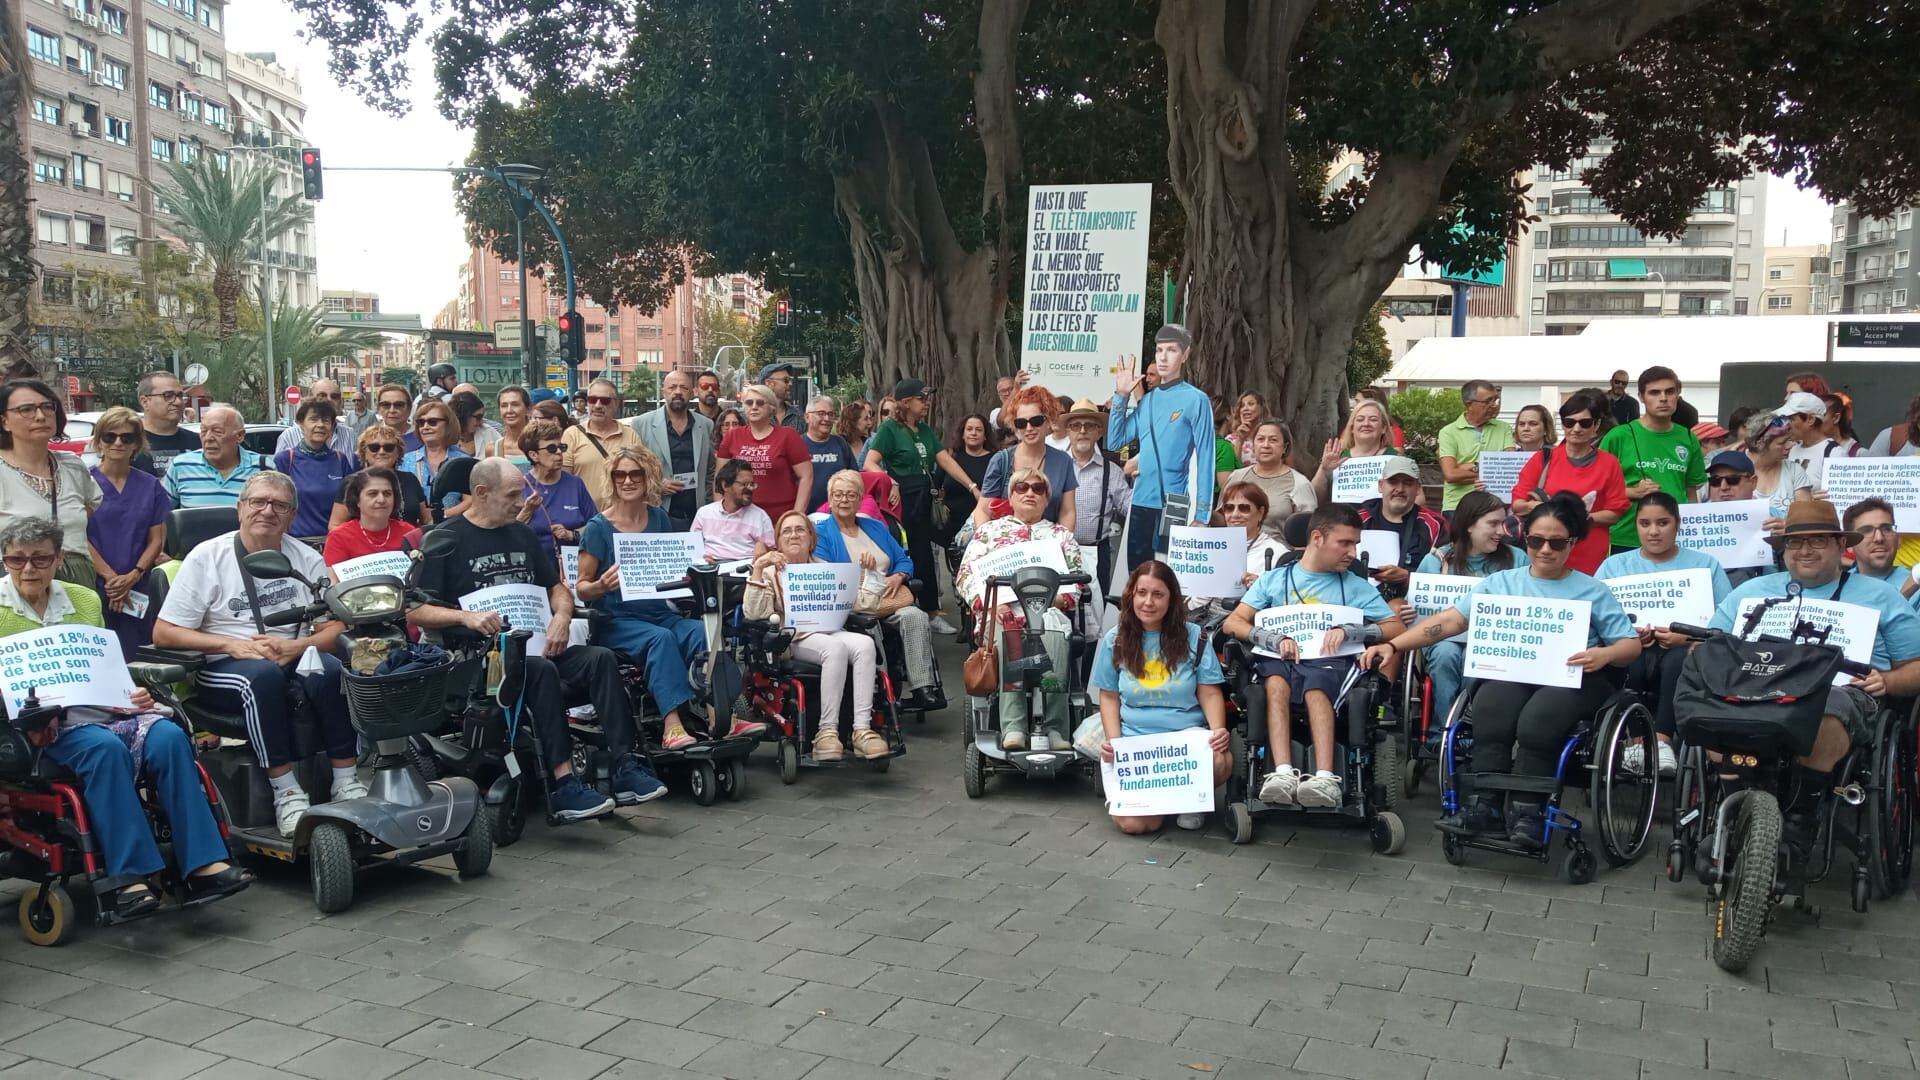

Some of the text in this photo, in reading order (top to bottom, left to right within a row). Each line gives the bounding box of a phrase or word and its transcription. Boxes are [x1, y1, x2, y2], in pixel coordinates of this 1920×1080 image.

[1035, 191, 1088, 211] HASTA QUE
[1034, 211, 1137, 231] EL TELETRANSPORTE
[1033, 232, 1090, 252] SEA VIABLE,
[1032, 253, 1105, 273] AL MENOS QUE
[1031, 273, 1121, 292] LOS TRANSPORTES
[1029, 293, 1139, 312] HABITUALES CUMPLAN
[1028, 314, 1098, 332] LAS LEYES DE
[1028, 333, 1099, 352] ACCESIBILIDAD.
[1049, 363, 1084, 371] COCEMFE
[1338, 468, 1384, 478] accesibili
[1339, 461, 1382, 470] Fomentar
[1884, 486, 1919, 495] pequeñas
[1679, 512, 1749, 525] ecesitamos
[1701, 525, 1730, 536] taxis
[1171, 535, 1228, 550] Necesitamos
[978, 549, 1025, 570] Protección
[1185, 550, 1208, 562] taxis
[342, 557, 410, 575] Son necesarios
[993, 558, 1028, 573] equipos
[788, 571, 835, 581] Protección
[1678, 578, 1691, 587] al
[789, 582, 847, 592] de equipos de
[1416, 581, 1430, 591] La
[1614, 588, 1683, 599] ersonal de
[468, 603, 478, 611] En
[492, 594, 525, 602] autobuses
[790, 591, 838, 603] movilidad y
[1414, 594, 1429, 603] es
[1433, 595, 1449, 604] un
[790, 602, 833, 612] asistencia
[1476, 602, 1574, 621] Solo un 18% de
[1826, 608, 1844, 618] que
[1261, 611, 1333, 628] Fomentar la
[1475, 615, 1564, 634] las estaciones
[1808, 614, 1841, 626] trenes,
[33, 636, 54, 647] un
[59, 632, 89, 644] 18%
[92, 634, 107, 646] de
[1474, 628, 1543, 646] de tren son
[28, 644, 105, 661] estaciones
[1472, 645, 1537, 660] accesibles
[3, 659, 90, 678] de tren son
[10, 671, 91, 692] accesibles
[1115, 743, 1188, 763] La movilidad
[1117, 758, 1198, 777] es un derecho
[1119, 773, 1194, 791] fundamental.
